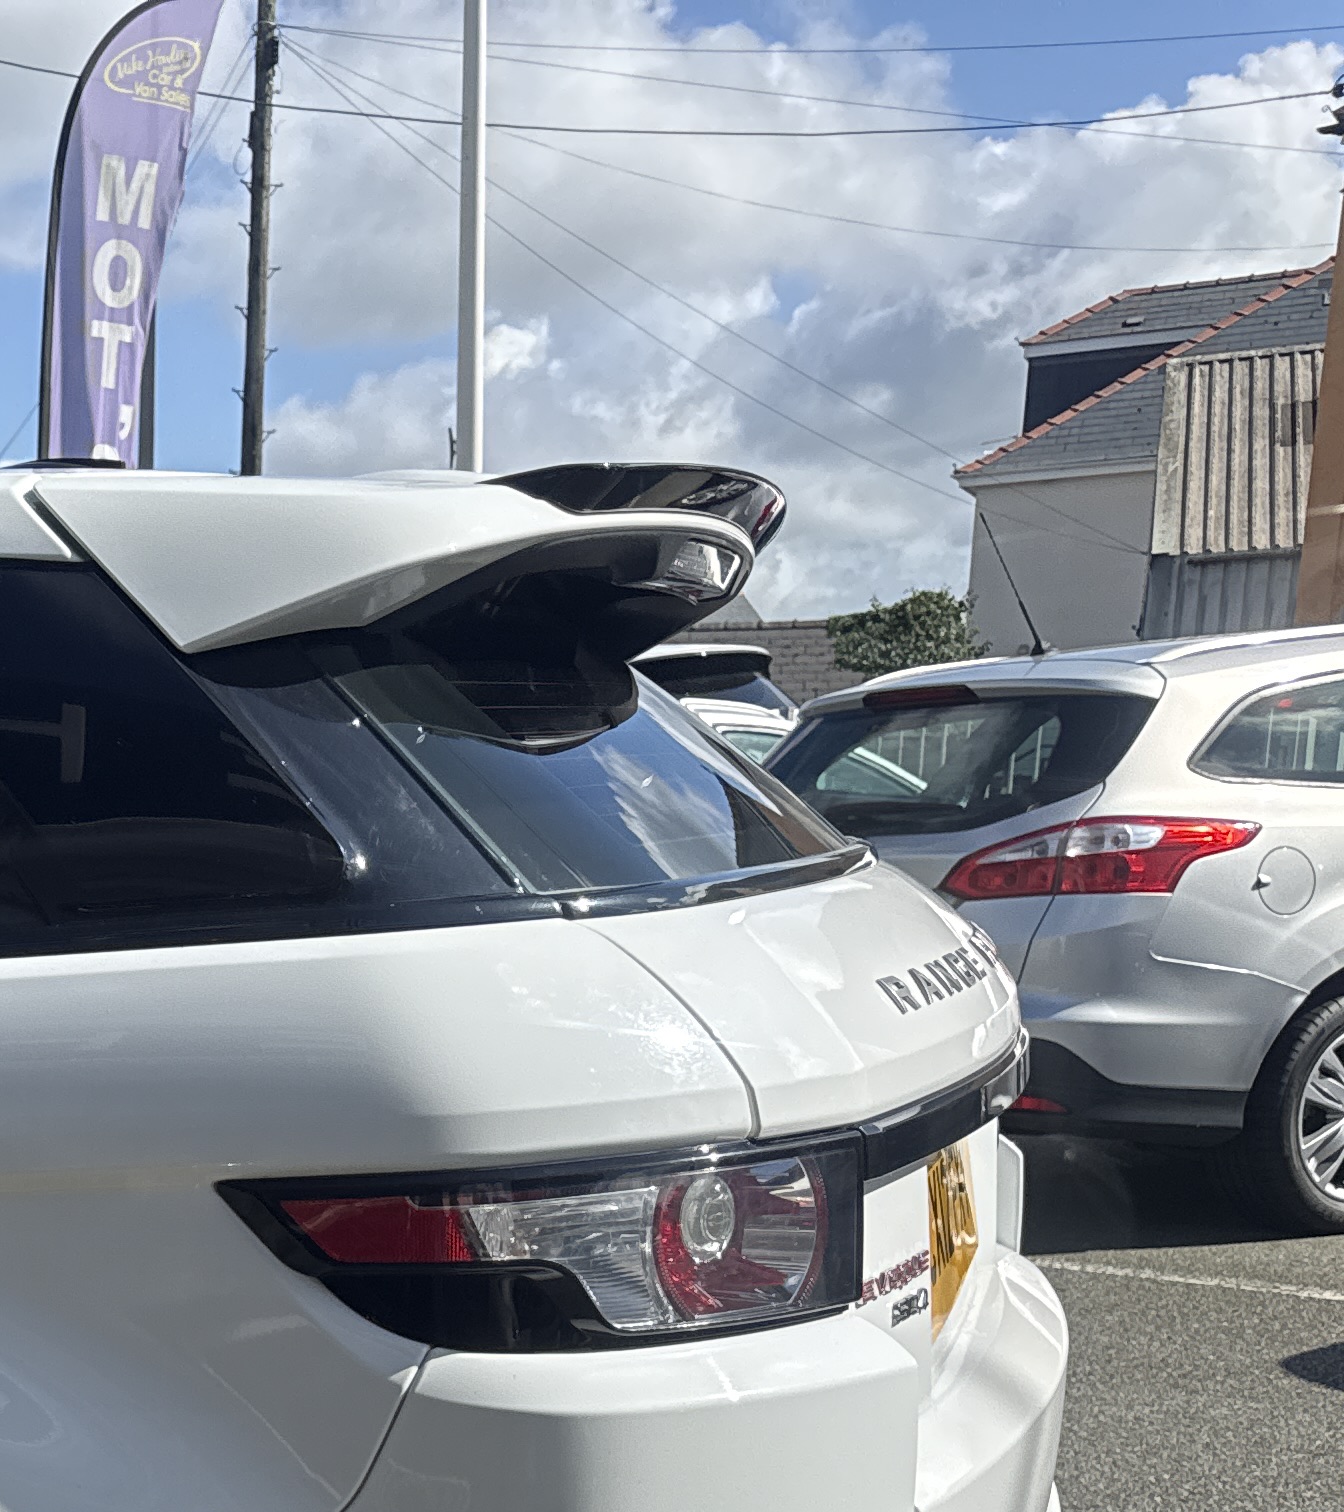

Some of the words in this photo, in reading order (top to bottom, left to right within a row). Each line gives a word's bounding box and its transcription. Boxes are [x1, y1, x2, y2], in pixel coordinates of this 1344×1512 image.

[148, 69, 173, 85] Car
[173, 74, 183, 88] &
[134, 81, 158, 97] Van
[160, 86, 190, 106] Sales
[875, 946, 987, 1014] RANGE
